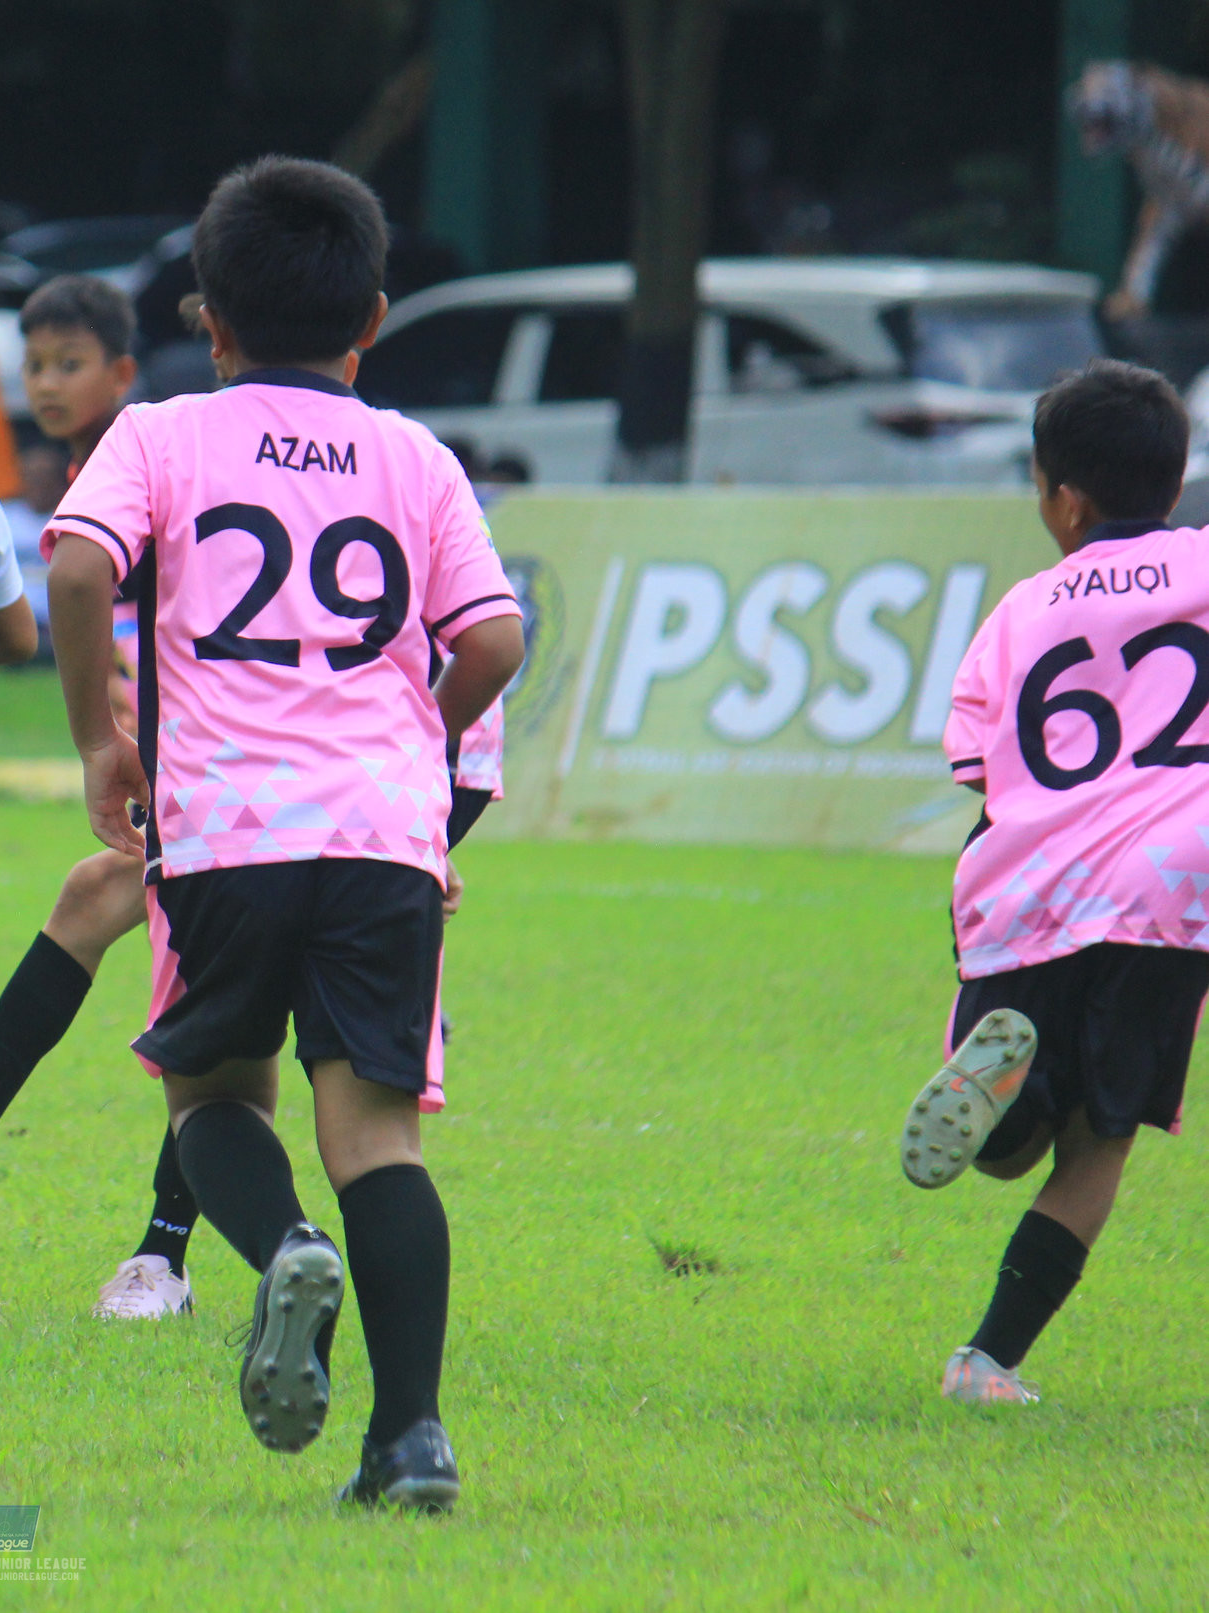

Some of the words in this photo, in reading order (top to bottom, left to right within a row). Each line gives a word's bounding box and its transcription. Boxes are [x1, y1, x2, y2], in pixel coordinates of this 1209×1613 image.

[255, 431, 358, 475] AZAM
[191, 502, 411, 672] 29
[601, 560, 989, 744] PSSI
[1048, 562, 1171, 606] SYAUQI
[1016, 620, 1209, 791] 62
